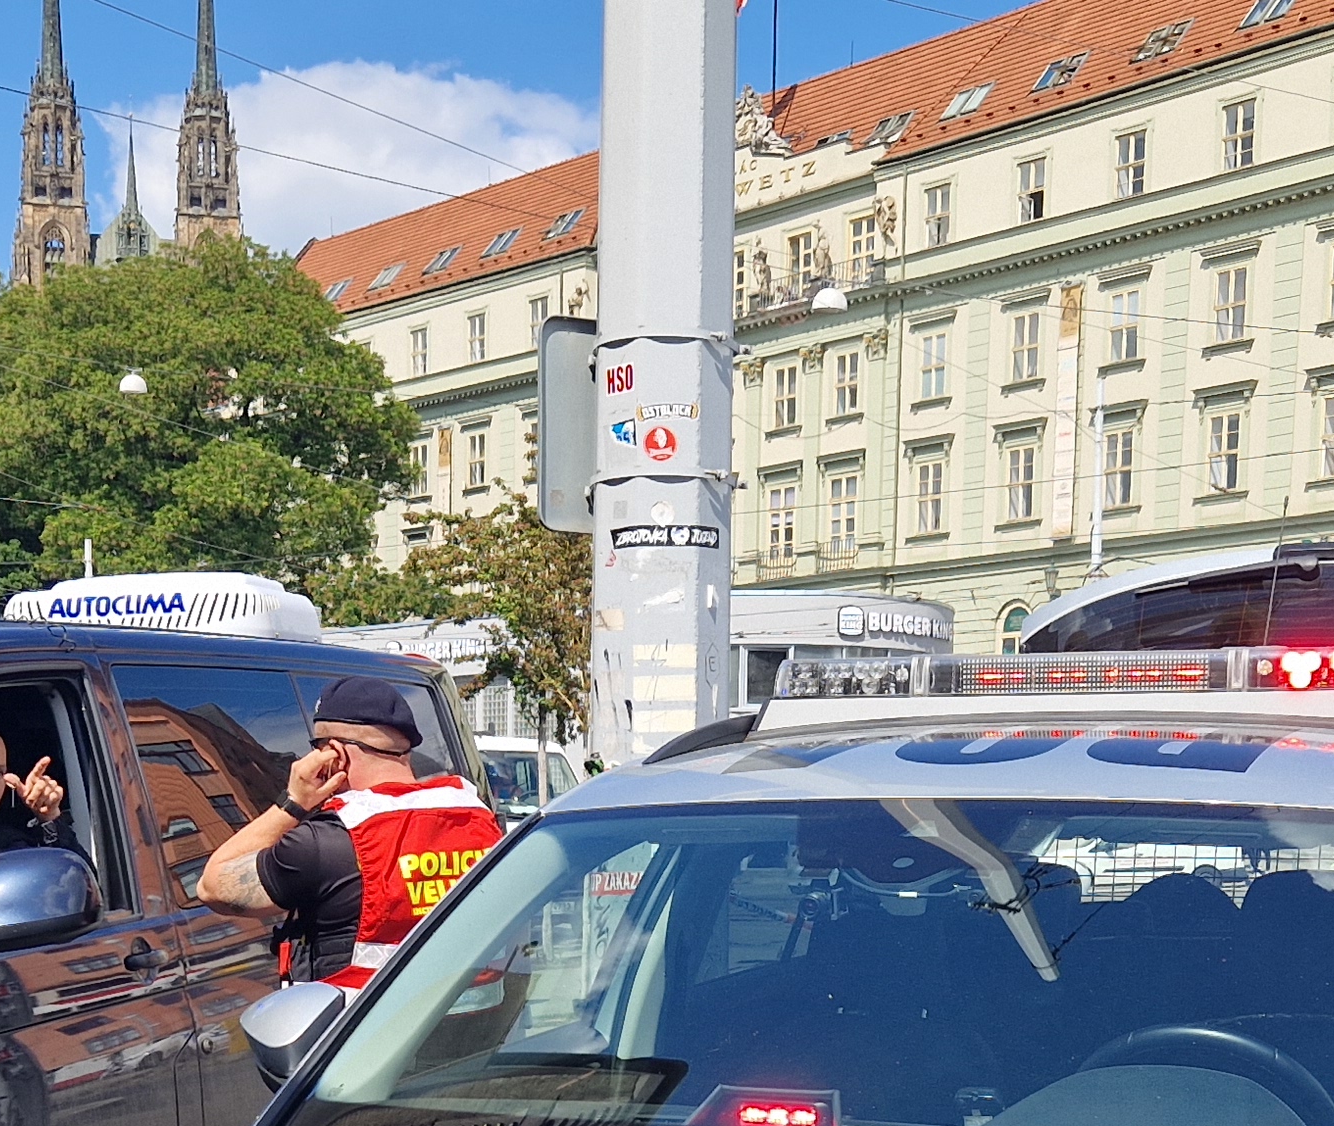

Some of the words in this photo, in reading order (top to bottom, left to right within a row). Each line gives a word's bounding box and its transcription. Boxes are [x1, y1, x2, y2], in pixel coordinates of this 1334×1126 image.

[607, 363, 634, 394] HSO
[48, 593, 186, 619] AUTOCLIMA
[868, 611, 931, 637] BURGER
[399, 848, 491, 878] POLIC
